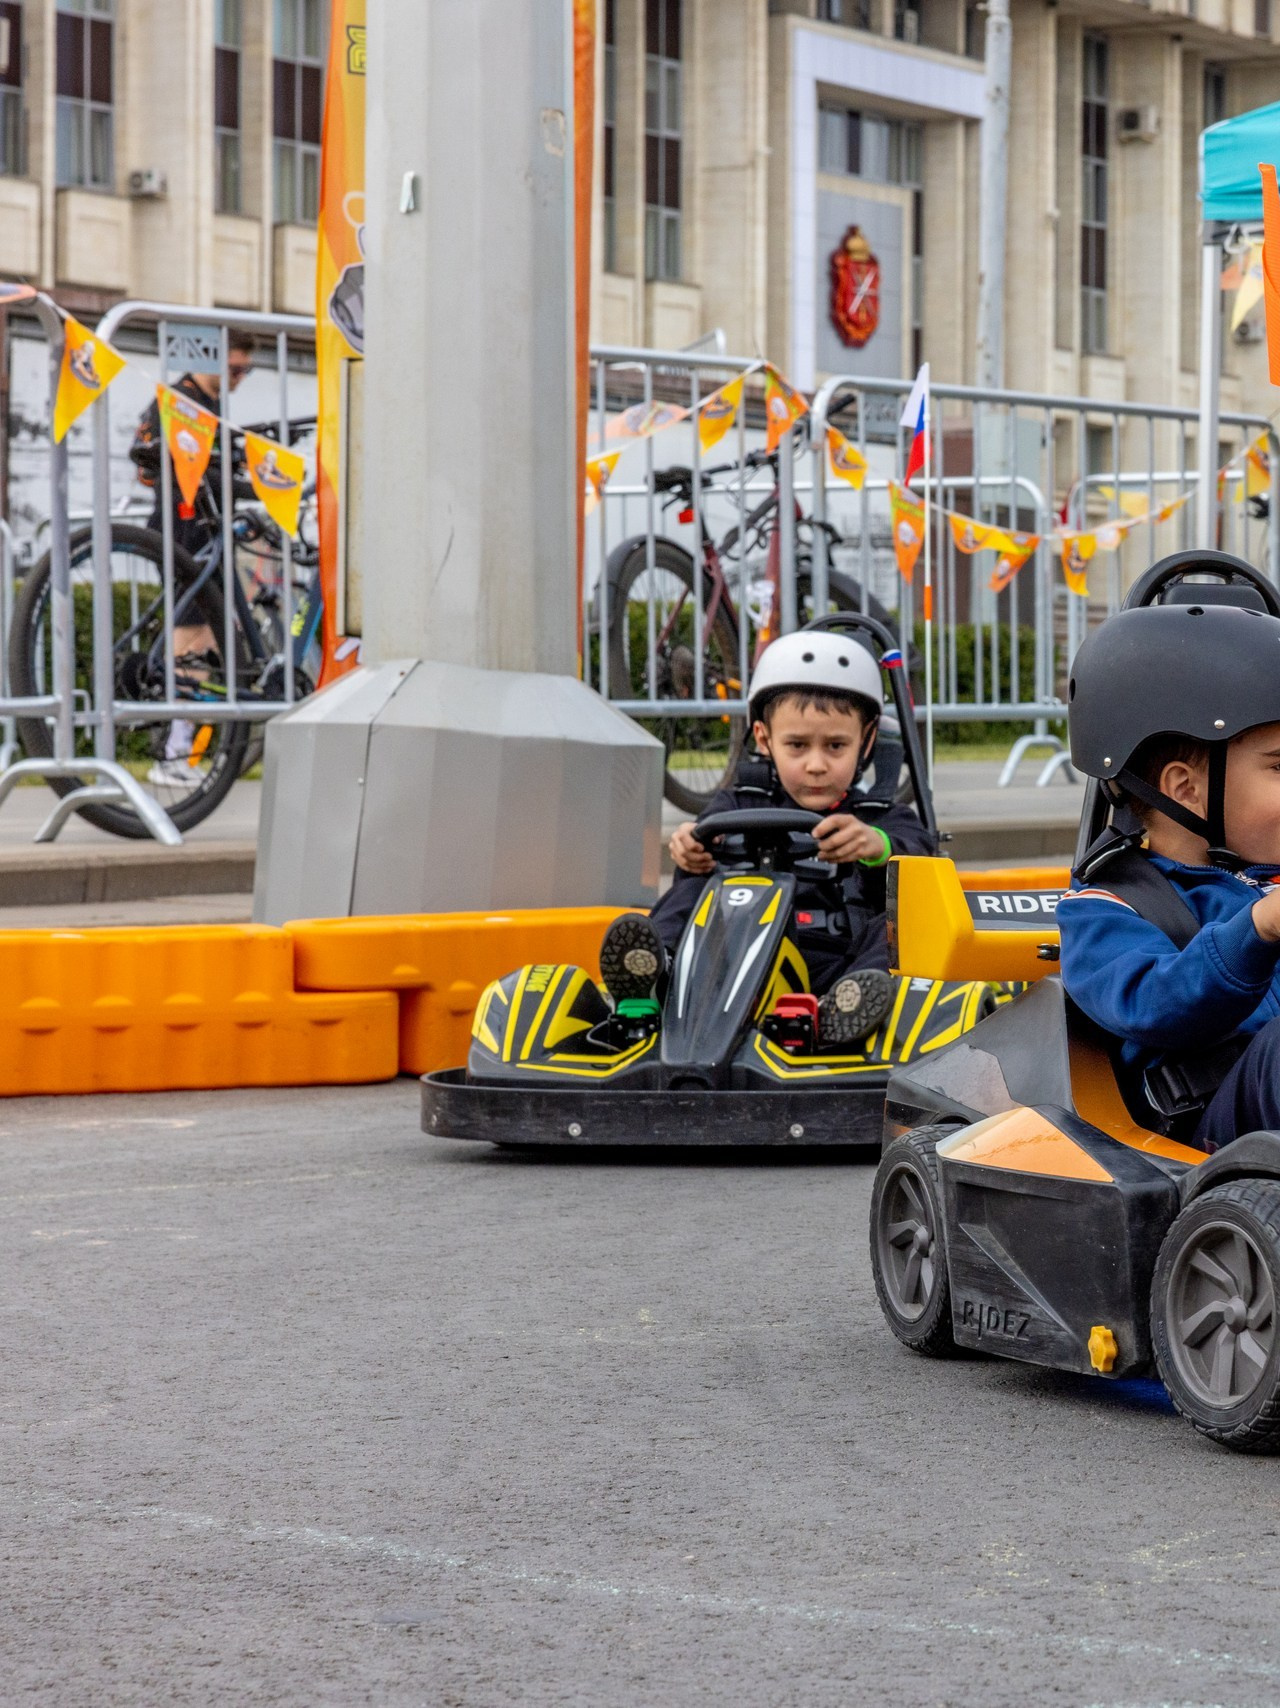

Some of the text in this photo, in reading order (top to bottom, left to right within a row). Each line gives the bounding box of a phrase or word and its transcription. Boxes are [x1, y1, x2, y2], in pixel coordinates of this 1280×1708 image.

[728, 888, 754, 906] 9
[977, 894, 1067, 913] RIDE
[963, 1300, 1032, 1341] RIDEZ
